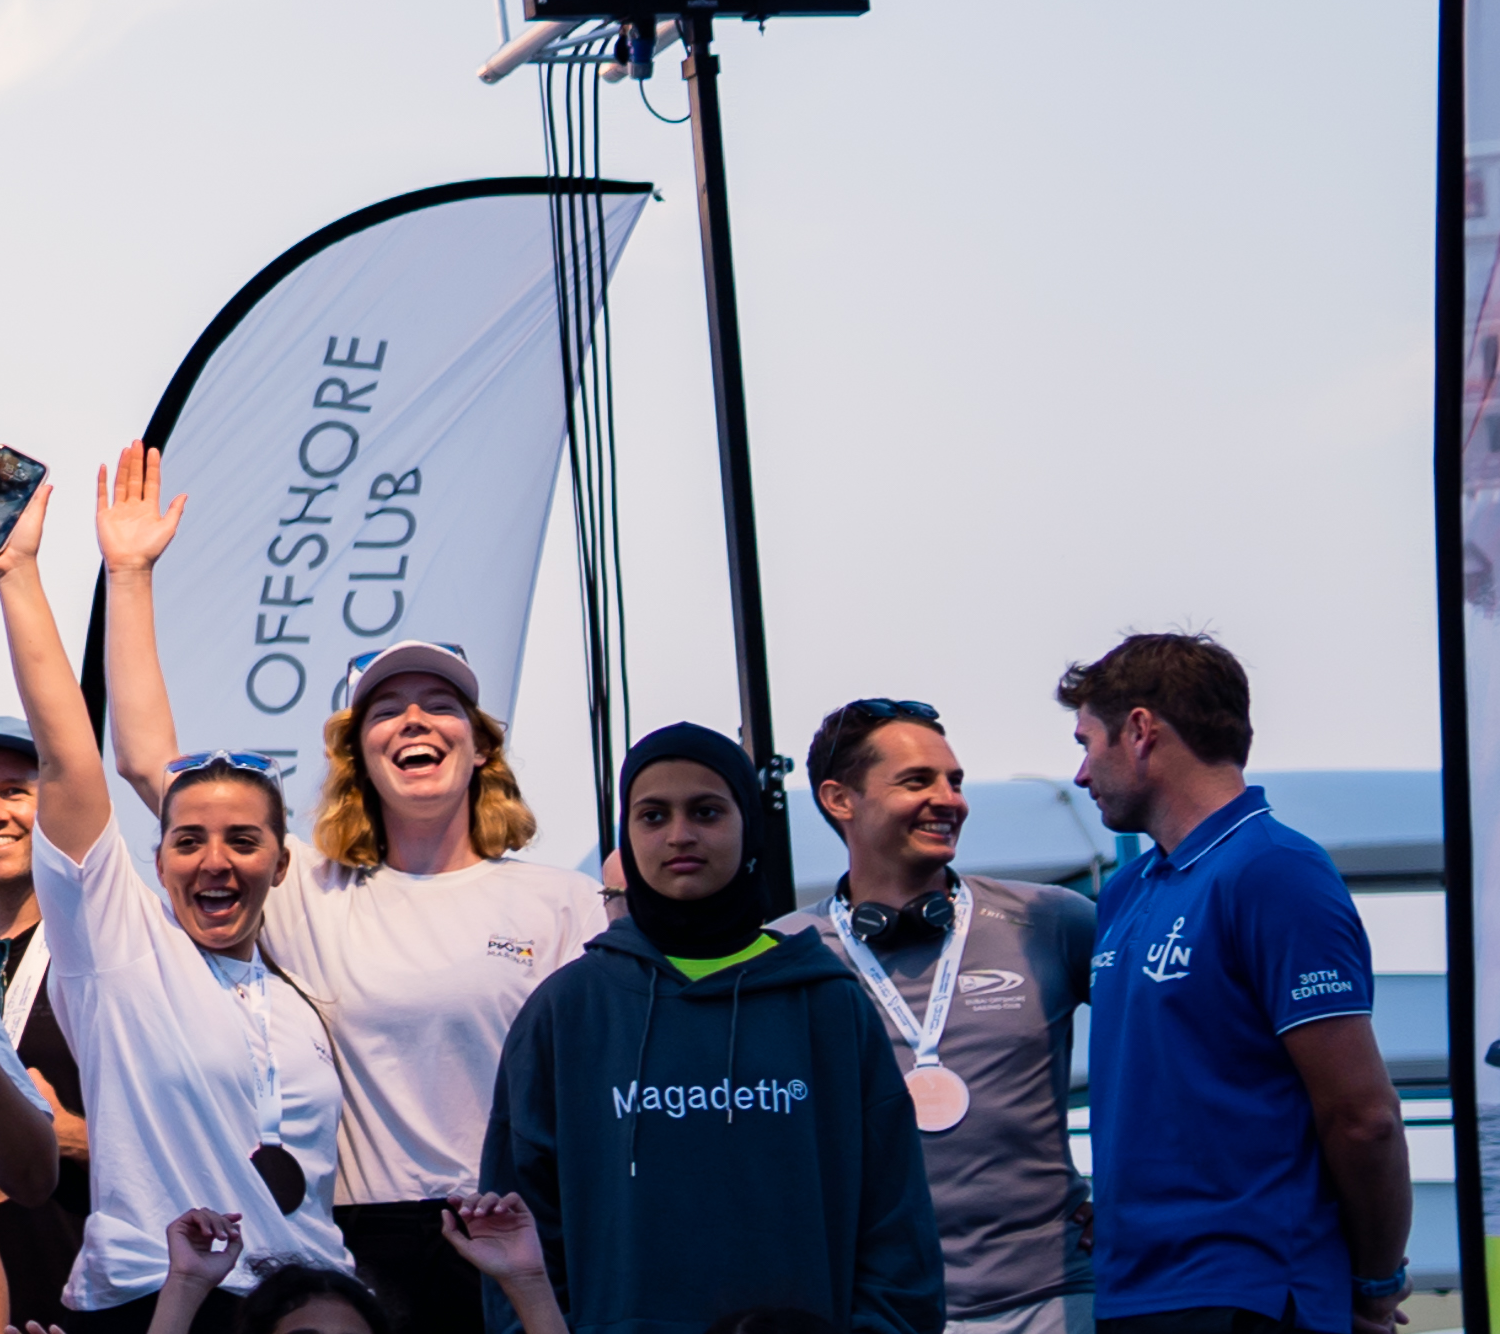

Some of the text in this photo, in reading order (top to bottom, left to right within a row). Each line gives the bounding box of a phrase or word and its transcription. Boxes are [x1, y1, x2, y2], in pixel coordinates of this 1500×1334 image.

[245, 334, 389, 715] OFFSHORE
[342, 466, 423, 637] CLUB
[1291, 980, 1353, 1001] EDITION
[1300, 969, 1339, 985] 30TH
